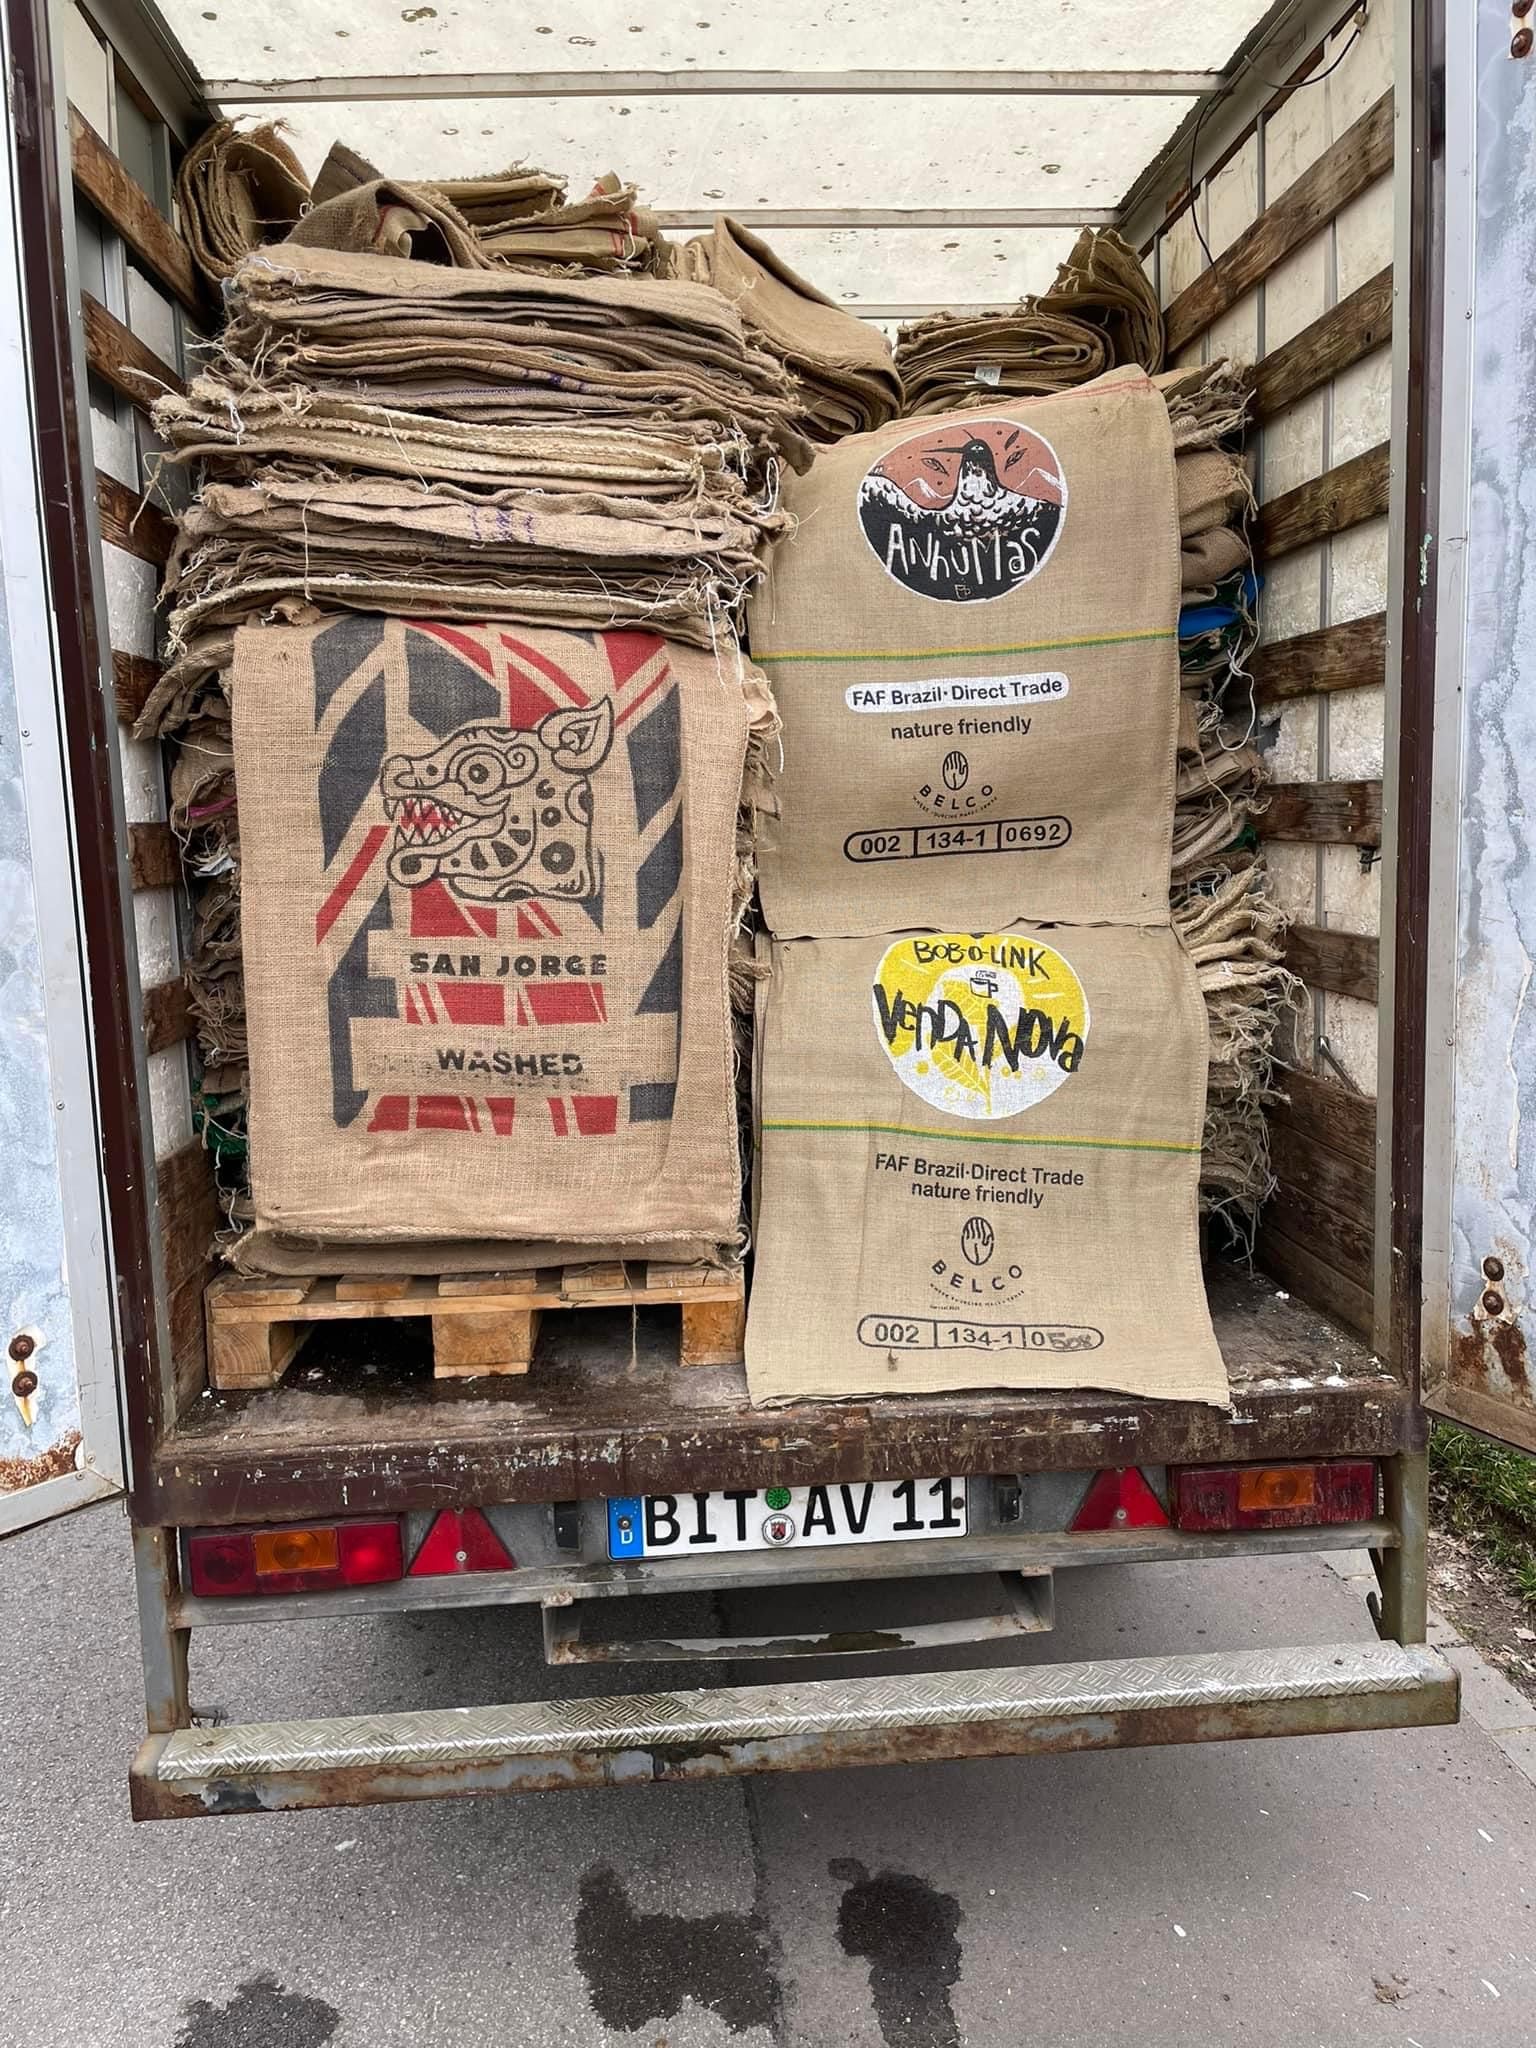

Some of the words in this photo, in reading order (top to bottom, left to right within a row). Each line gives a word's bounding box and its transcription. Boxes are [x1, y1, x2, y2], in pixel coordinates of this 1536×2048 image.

[852, 690, 886, 705] FAF
[952, 684, 1006, 700] Direct
[1010, 678, 1062, 697] Trade
[891, 722, 953, 739] nature
[959, 716, 1032, 735] friendly
[919, 784, 993, 810] BELCO
[860, 836, 900, 855] 002
[927, 829, 985, 848] 134-1
[1006, 824, 1061, 841] 0692
[410, 953, 481, 976] SAN
[496, 954, 607, 976] JORGE
[437, 1050, 583, 1076] WASHED
[875, 1153, 909, 1171] FAF
[972, 1164, 1027, 1183] Direct
[1032, 1167, 1084, 1185] Trade
[912, 1182, 970, 1200] nature
[975, 1185, 1044, 1208] friendly
[932, 1259, 1022, 1293] BELCO
[875, 1323, 920, 1344] 002
[948, 1327, 1013, 1346] 134-1
[620, 1530, 633, 1544] D
[647, 1490, 758, 1546] BIT
[803, 1483, 874, 1537] AV
[893, 1478, 961, 1531] 11
